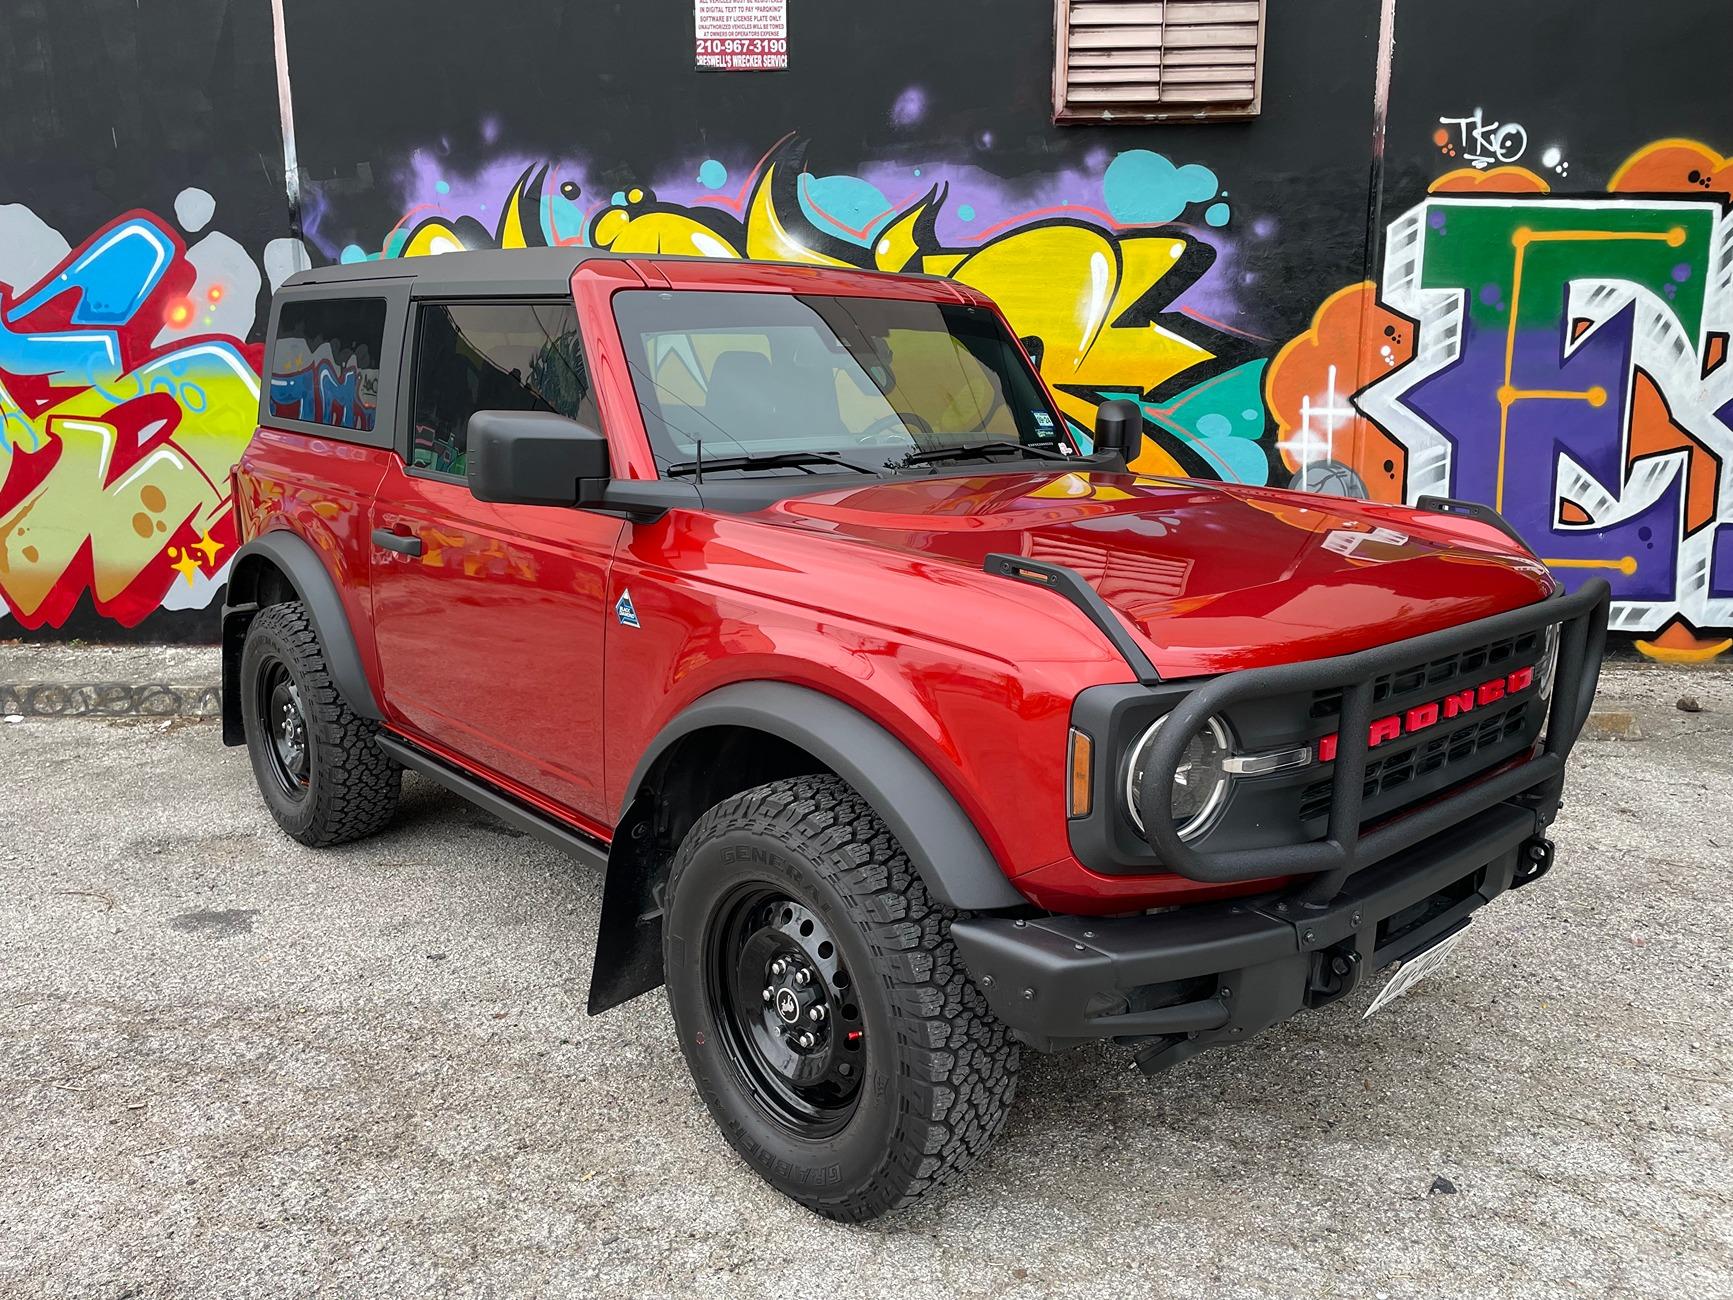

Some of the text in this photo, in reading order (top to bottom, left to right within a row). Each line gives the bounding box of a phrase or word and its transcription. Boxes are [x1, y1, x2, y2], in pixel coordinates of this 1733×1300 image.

[696, 40, 786, 53] 210-967-3190
[732, 54, 763, 68] WRECKER
[1440, 106, 1527, 164] TKO
[720, 845, 833, 924] GENERAL
[728, 1118, 842, 1186] GRABBER
